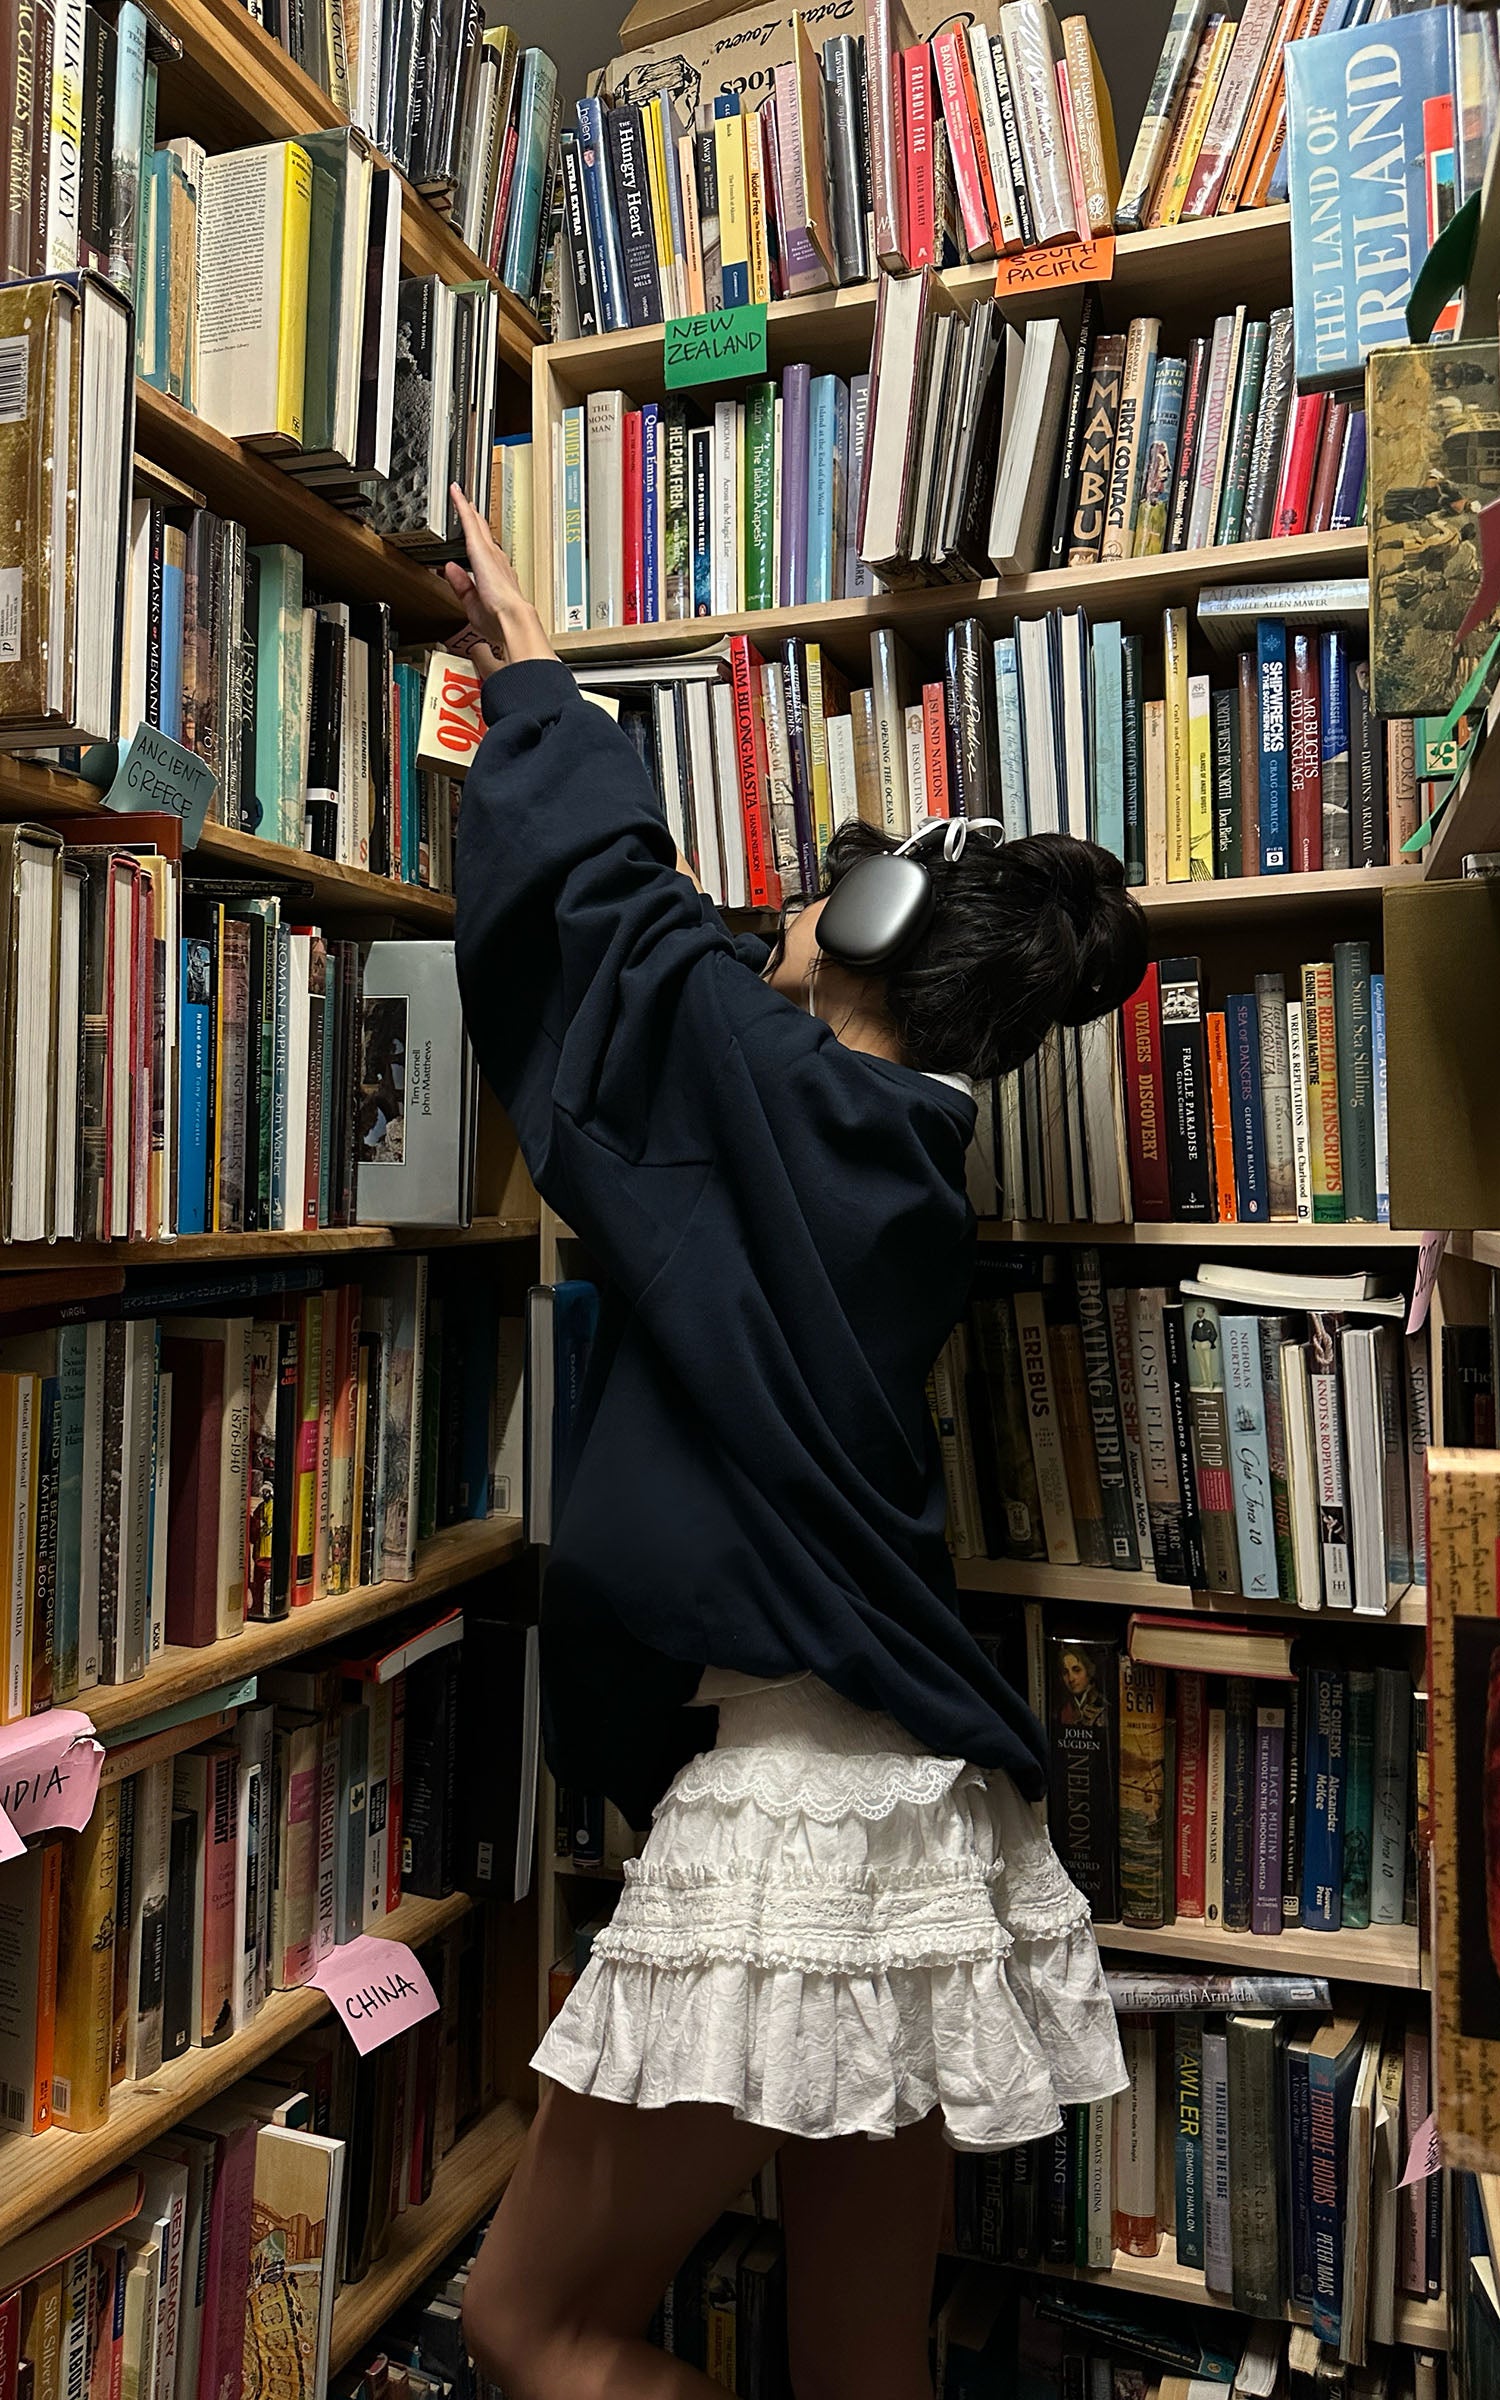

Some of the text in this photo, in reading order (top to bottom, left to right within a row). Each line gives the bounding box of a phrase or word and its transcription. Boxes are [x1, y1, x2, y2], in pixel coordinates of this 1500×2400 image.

[59, 0, 82, 230] MILK and HONEY
[911, 65, 926, 153] FRIENDLY FIRE
[939, 45, 956, 98] BAVADRA
[992, 43, 1024, 187] RABUKA NO OTHER WAY
[1076, 24, 1095, 119] THE HAPPY ISLAND
[580, 107, 592, 141] helen
[620, 127, 636, 189] Hungry
[627, 190, 645, 238] Heart
[1306, 105, 1347, 372] THE LAND OF
[1345, 43, 1412, 364] IRELAND
[1007, 257, 1098, 285] PACIFIC
[667, 329, 762, 365] ZEALAND
[673, 313, 735, 338] NEW
[589, 413, 615, 425] MOON
[591, 424, 612, 434] MAN
[592, 404, 610, 413] THE
[1200, 335, 1232, 490] WHAT DARWIN SAW
[564, 418, 581, 543] DIVIDED ISLES
[1073, 378, 1119, 540] MAMBU
[1108, 398, 1137, 529] FIRST CONTACT
[240, 628, 256, 733] AESOPIC
[1263, 662, 1270, 673] OF
[1263, 692, 1271, 729] SOUTHERN
[1269, 661, 1285, 753] SHIPWRECKS
[137, 735, 206, 792] ANCIENT
[361, 720, 369, 779] EHRENBERG
[734, 646, 761, 872] TAIM BILONG MASTA HANK NELSON
[880, 719, 895, 824] OPENING THE OCEANS
[911, 743, 924, 814] RESOLUTION
[929, 698, 943, 798] ISLAND NATION
[1263, 732, 1272, 753] SEAS
[1290, 689, 1304, 792] BAD LANGUAGE
[1303, 698, 1319, 778] MR BLIGH'S
[128, 761, 193, 818] GREECE
[276, 941, 288, 997] ROMAN
[275, 1002, 287, 1076] EMPIRE
[1304, 970, 1320, 1085] KENNETH GORDON McINTYRE
[274, 1093, 285, 1121] John
[411, 1048, 421, 1105] Tim Cornell
[422, 1040, 432, 1116] John Matthews
[1134, 1001, 1158, 1162] VOYAGES DISCOVERY
[1182, 1047, 1198, 1161] FRAGILE PARADISE
[1238, 1005, 1257, 1191] SEA OF DANGERS GEOFFREY BLAINEY
[1290, 1013, 1307, 1198] WRECKS & REPUTATIONS Don Charlwood
[1317, 967, 1342, 1192] THE REBELLO TRANSCRIPTS
[1022, 1325, 1049, 1418] EREBUS
[1077, 1279, 1112, 1401] BOATING
[1229, 1330, 1242, 1391] COURTNEY
[1240, 1331, 1253, 1390] NICHOLAS
[230, 1408, 242, 1474] 1876-1940
[1092, 1403, 1126, 1491] BIBLE
[1137, 1329, 1169, 1489] LOST FLEET
[1172, 1380, 1194, 1518] ALEJANDRO MALASPINA
[1316, 1379, 1334, 1502] KNOTS & ROPEWORK
[38, 1474, 50, 1599] KATHERINE BOO
[44, 1400, 62, 1665] BEHIND THE BEAUTIFUL FOREVERS
[1057, 1739, 1101, 1752] SUGDEN
[1063, 1728, 1093, 1740] JOHN
[1126, 1690, 1156, 1714] SEA
[1318, 1681, 1331, 1736] CORSAIR
[1330, 1681, 1344, 1758] THE QUEEN'S
[1067, 1753, 1092, 1851] NELSON
[1258, 1735, 1269, 1890] THE REVOLT ON THE SCHOONER AMISTAD
[1268, 1765, 1280, 1862] BLACK MUTINY
[1315, 1773, 1328, 1811] McKee
[1327, 1776, 1341, 1833] Alexander
[319, 1763, 337, 1922] SHANGHAI FURY
[346, 1973, 419, 2019] CHINA
[1119, 1987, 1253, 2008] The Spanish Armada
[1179, 2025, 1201, 2138] TRAWLER
[1093, 2104, 1103, 2213] SLOW BOATS TO CHINA
[1216, 2081, 1228, 2199] TRAVELING ON THE EDGE
[1311, 2088, 1337, 2208] TERRIBLE HOURS
[1185, 2141, 1194, 2233] REDMOND O'HANLON
[165, 2198, 183, 2357] RED MEMORY
[1315, 2231, 1334, 2297] PETER MAAS
[42, 2295, 58, 2383] Silk Silver
